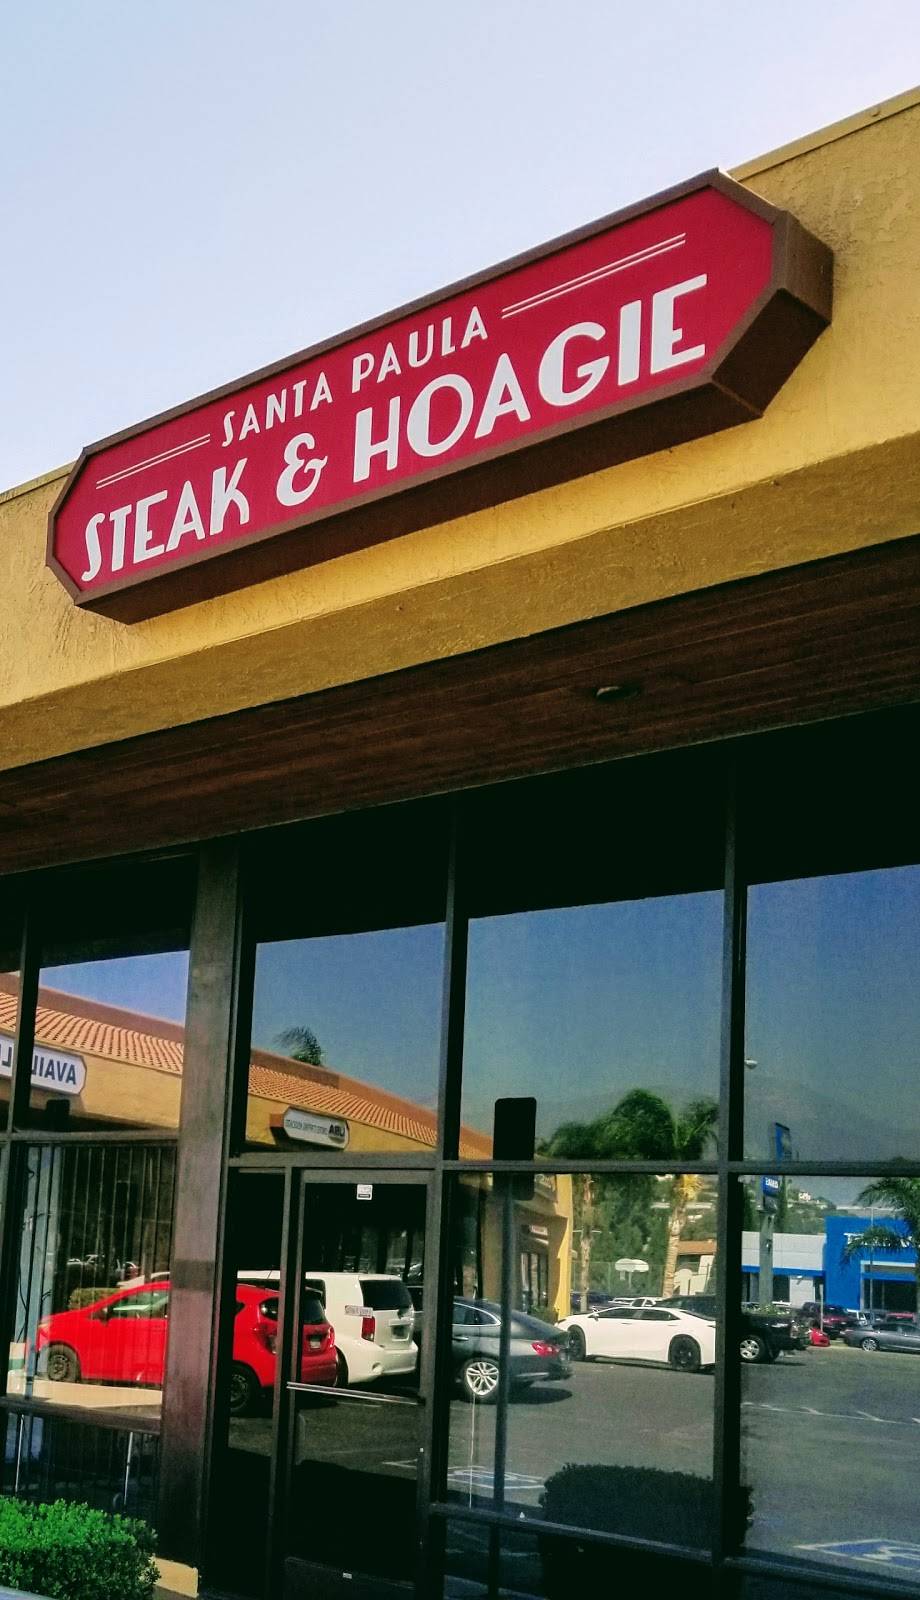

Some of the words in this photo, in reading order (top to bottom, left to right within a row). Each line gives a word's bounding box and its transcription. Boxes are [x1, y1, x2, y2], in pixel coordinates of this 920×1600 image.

[81, 457, 250, 582] STEAK
[276, 432, 328, 507] &
[352, 273, 708, 483] HOAGIE
[222, 371, 333, 447] SANTA
[351, 306, 488, 394] PAULA
